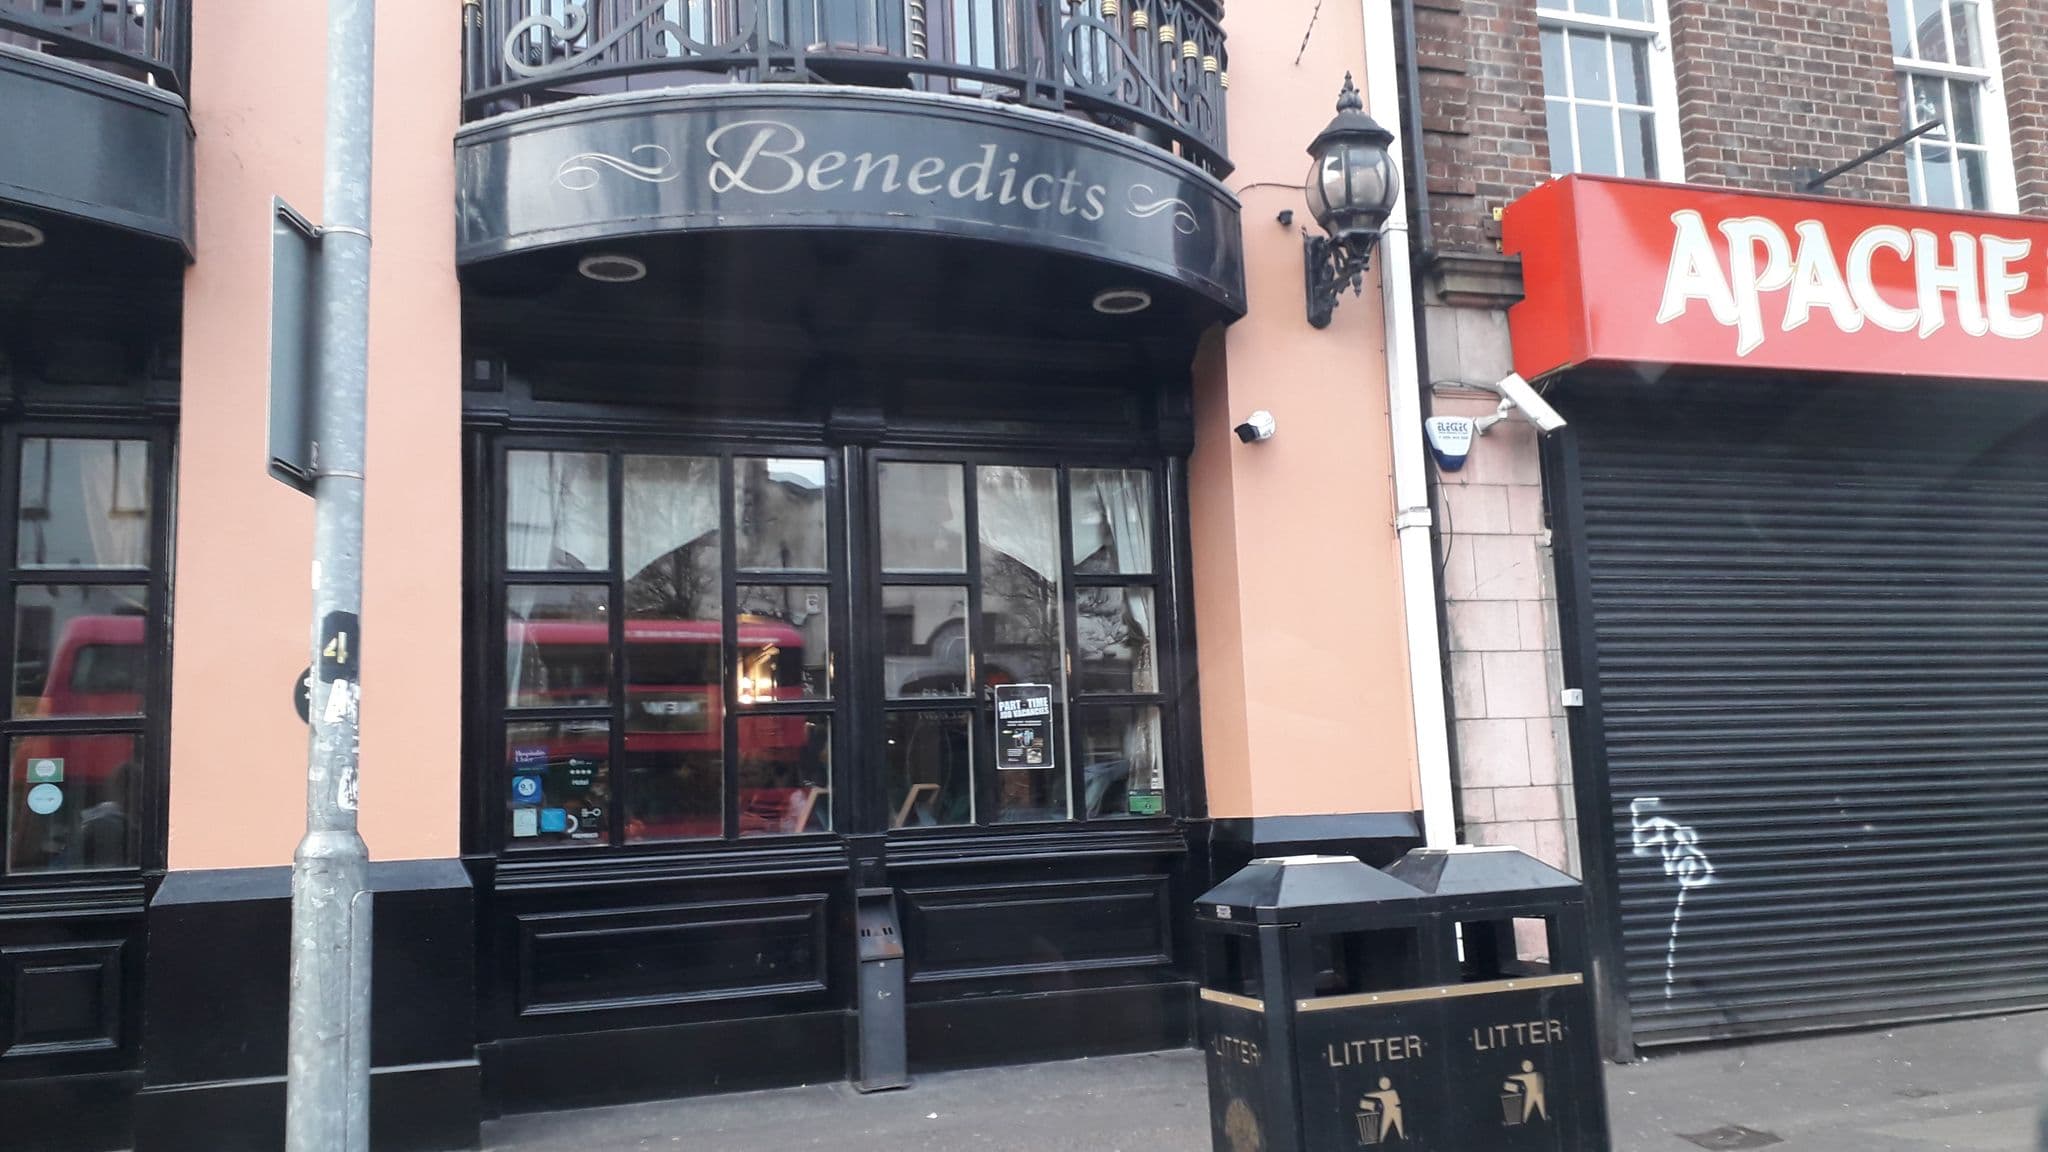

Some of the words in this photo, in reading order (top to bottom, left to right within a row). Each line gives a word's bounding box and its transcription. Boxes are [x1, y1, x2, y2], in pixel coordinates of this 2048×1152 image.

[706, 119, 1107, 221] Benedicts
[1655, 209, 2045, 357] APACHE
[323, 631, 348, 663] 4
[1215, 1034, 1259, 1065] LITTER
[1328, 1035, 1423, 1067] LITTER
[1473, 1020, 1563, 1050] LITTER
